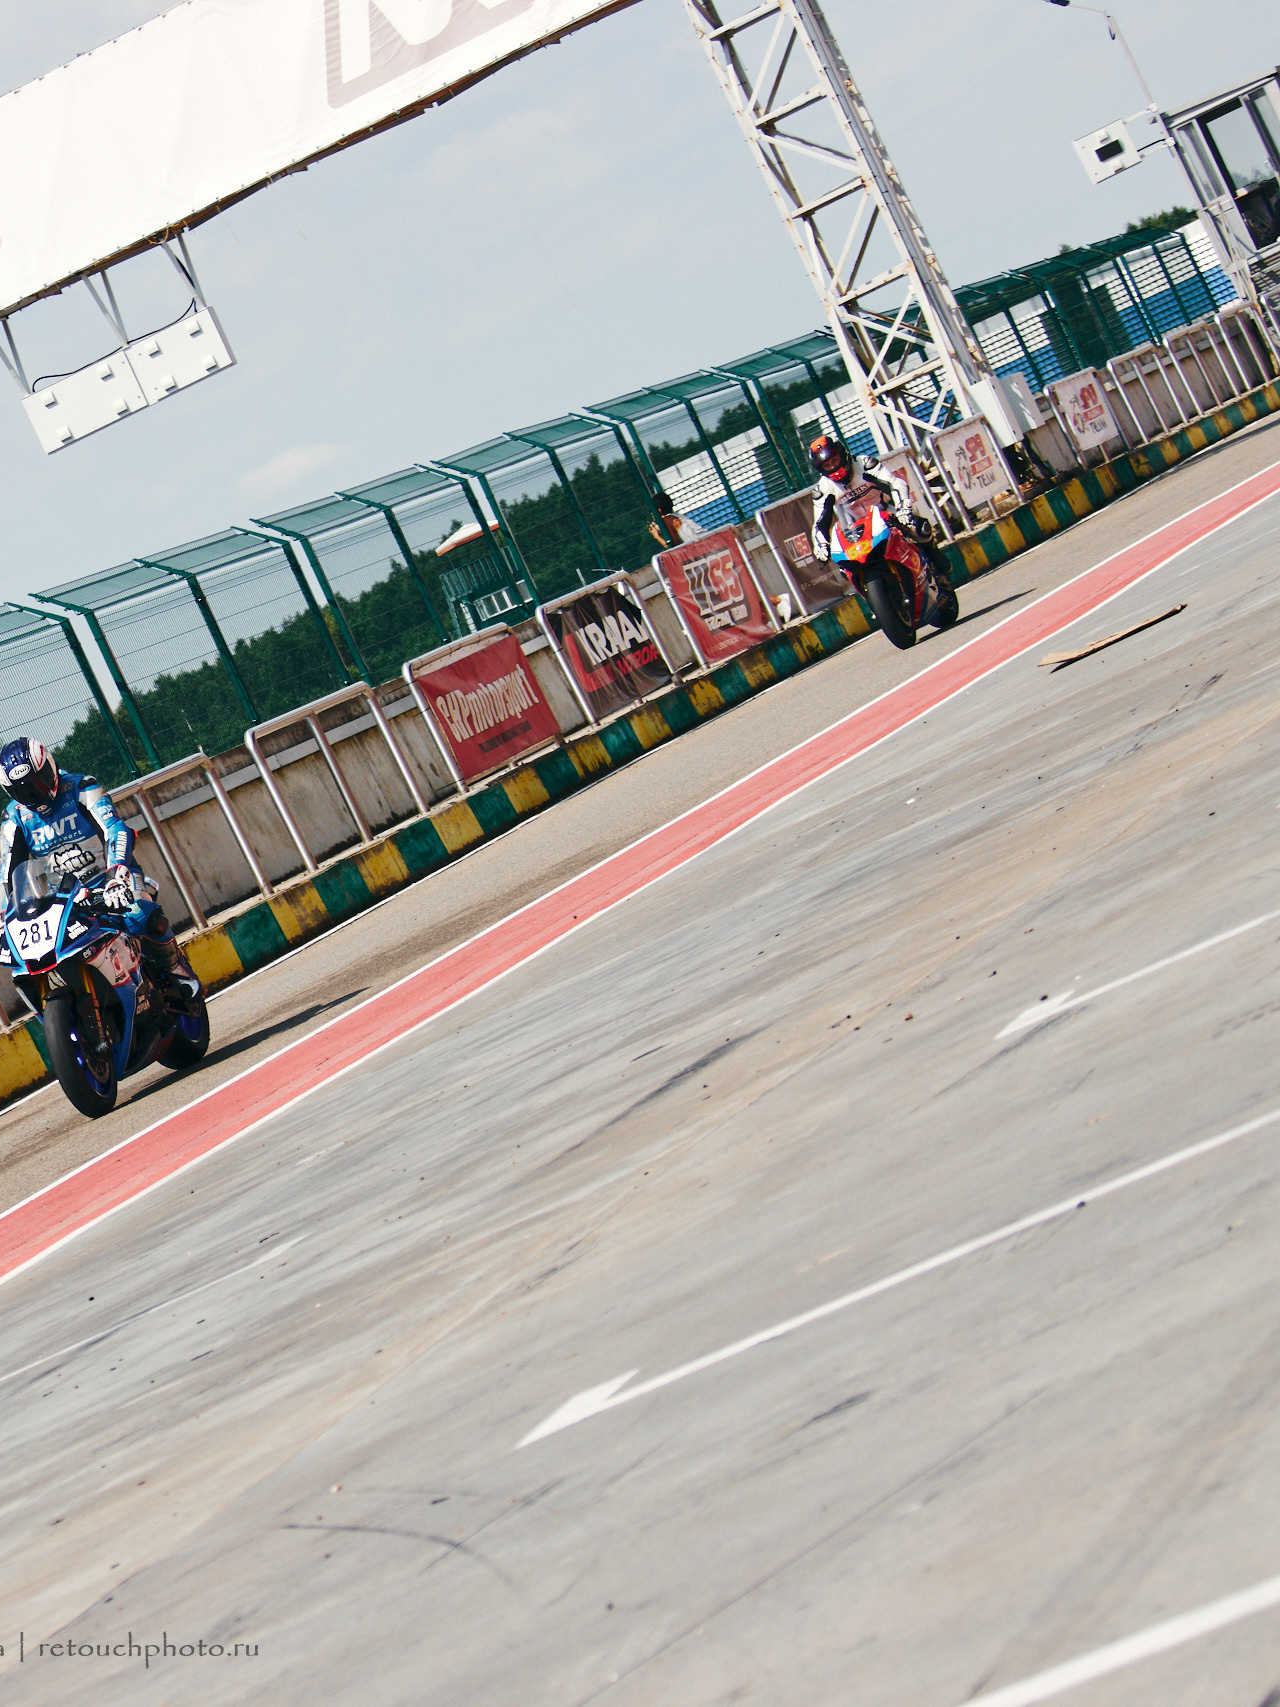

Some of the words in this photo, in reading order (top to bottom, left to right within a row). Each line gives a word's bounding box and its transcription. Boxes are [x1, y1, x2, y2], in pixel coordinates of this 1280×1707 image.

[847, 540, 872, 560] 52
[32, 812, 78, 845] RWT
[34, 829, 82, 852] motorsport
[115, 830, 128, 861] YAMAHA
[19, 919, 53, 951] 281
